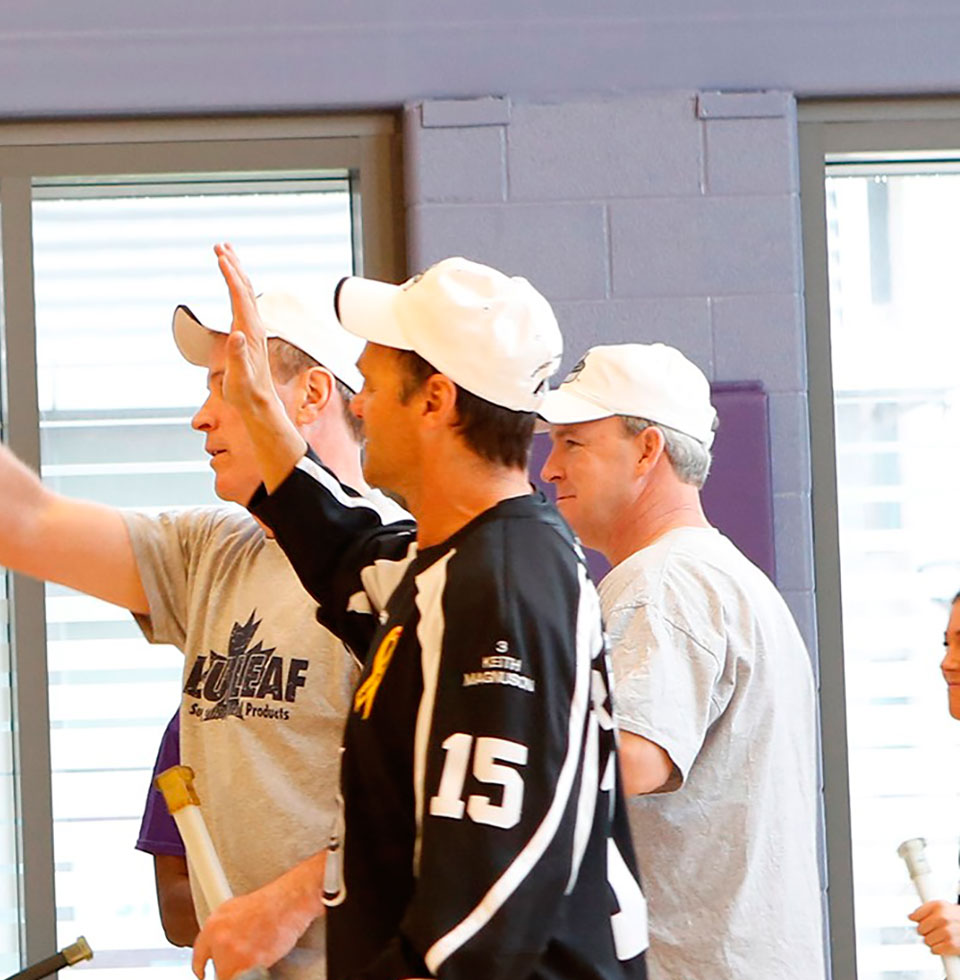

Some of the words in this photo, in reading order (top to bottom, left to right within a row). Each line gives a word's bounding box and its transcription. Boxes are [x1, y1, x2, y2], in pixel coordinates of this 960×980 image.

[495, 640, 509, 653] 3
[245, 702, 290, 720] Products
[429, 732, 529, 830] 15
